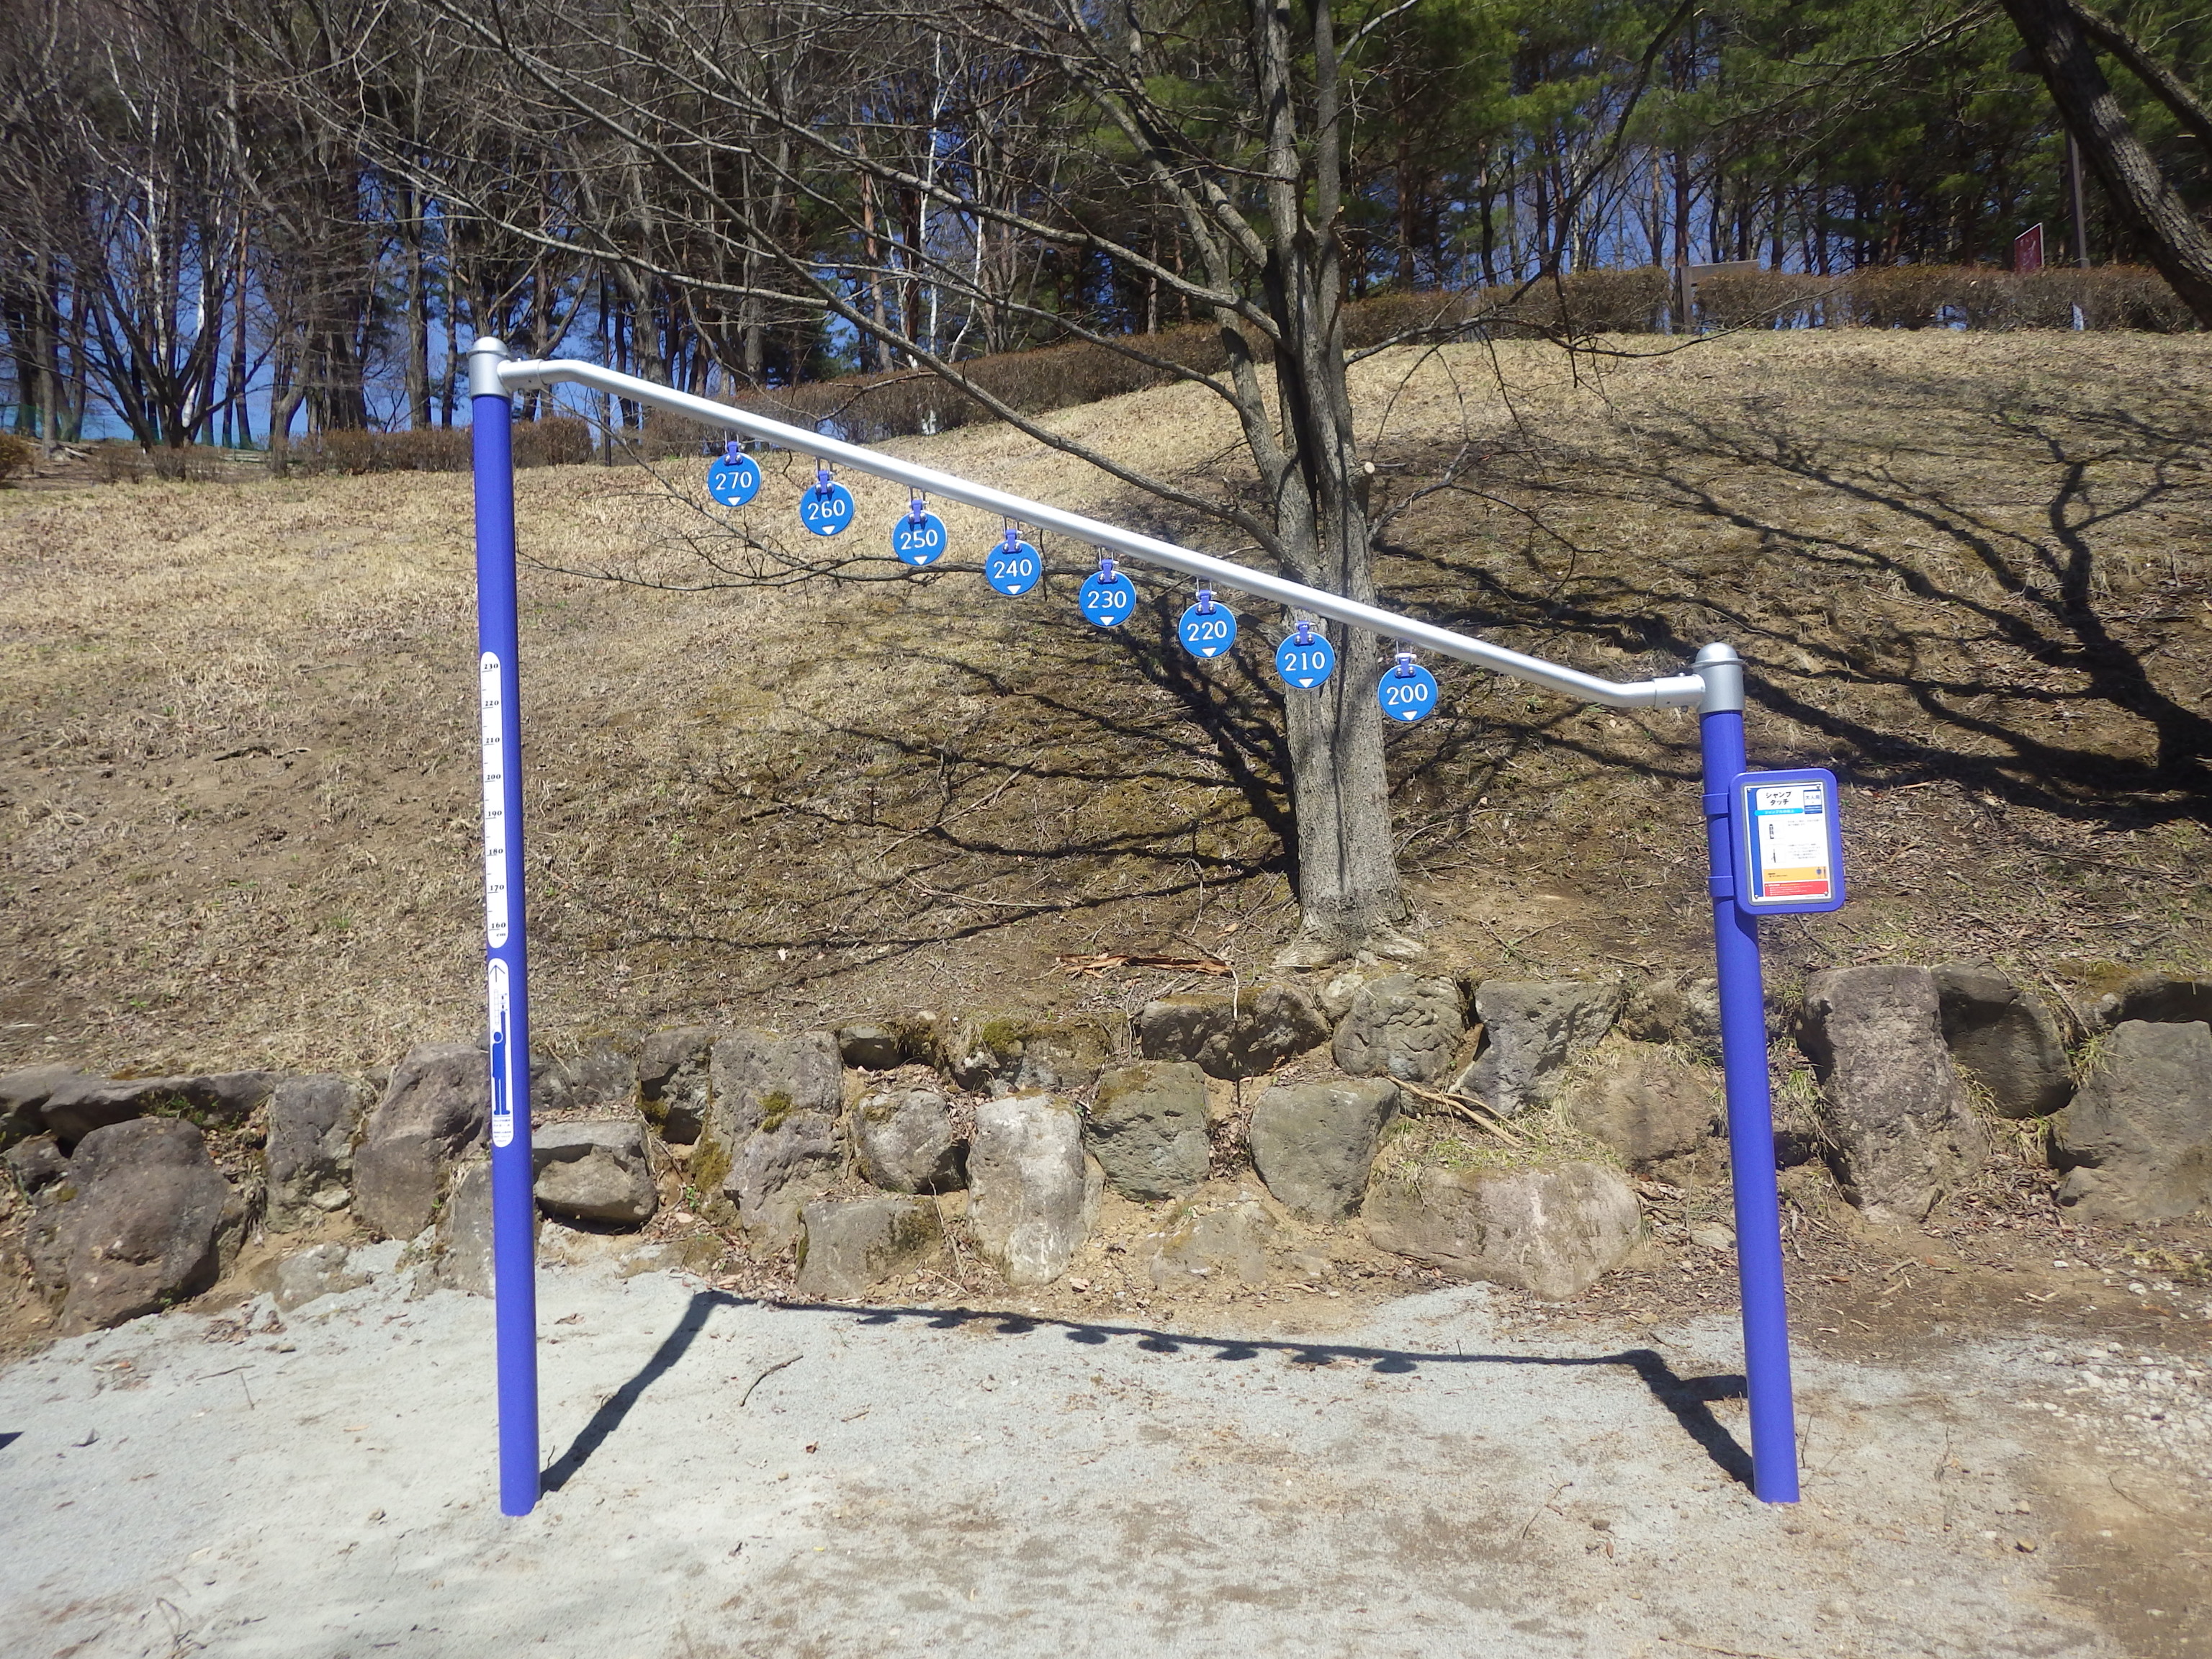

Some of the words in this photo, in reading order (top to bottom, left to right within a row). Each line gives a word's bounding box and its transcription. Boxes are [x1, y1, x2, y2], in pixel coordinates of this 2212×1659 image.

[714, 471, 753, 491] 270
[807, 499, 846, 521] 260
[899, 529, 939, 550] 250
[993, 559, 1033, 579] 240
[1087, 590, 1128, 608] 230
[1187, 620, 1228, 642] 220
[1284, 652, 1326, 672] 210
[1386, 683, 1429, 706] 200
